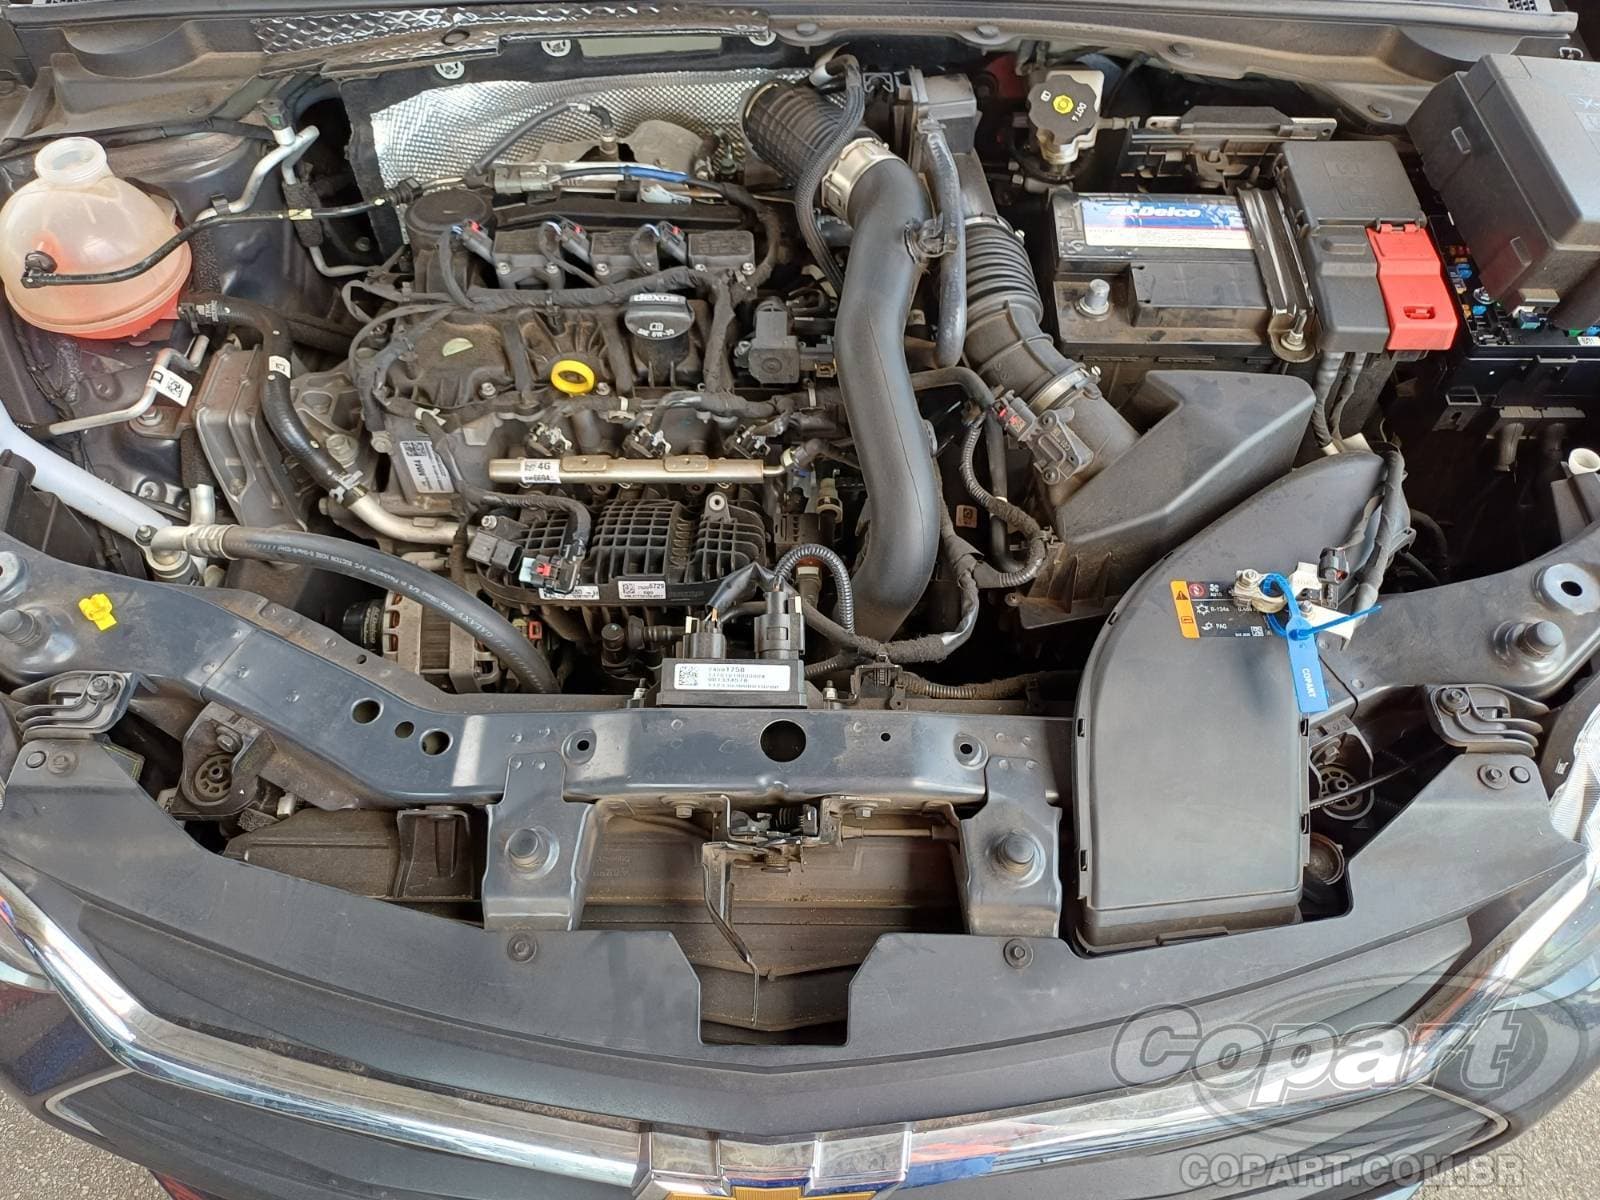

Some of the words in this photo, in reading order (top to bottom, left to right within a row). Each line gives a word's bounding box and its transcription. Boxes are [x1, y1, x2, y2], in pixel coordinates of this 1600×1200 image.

[1075, 101, 1087, 117] DOT
[1071, 114, 1079, 122] 4
[537, 462, 551, 470] 4G
[455, 612, 494, 638] GALAXY
[1301, 667, 1317, 698] COPART
